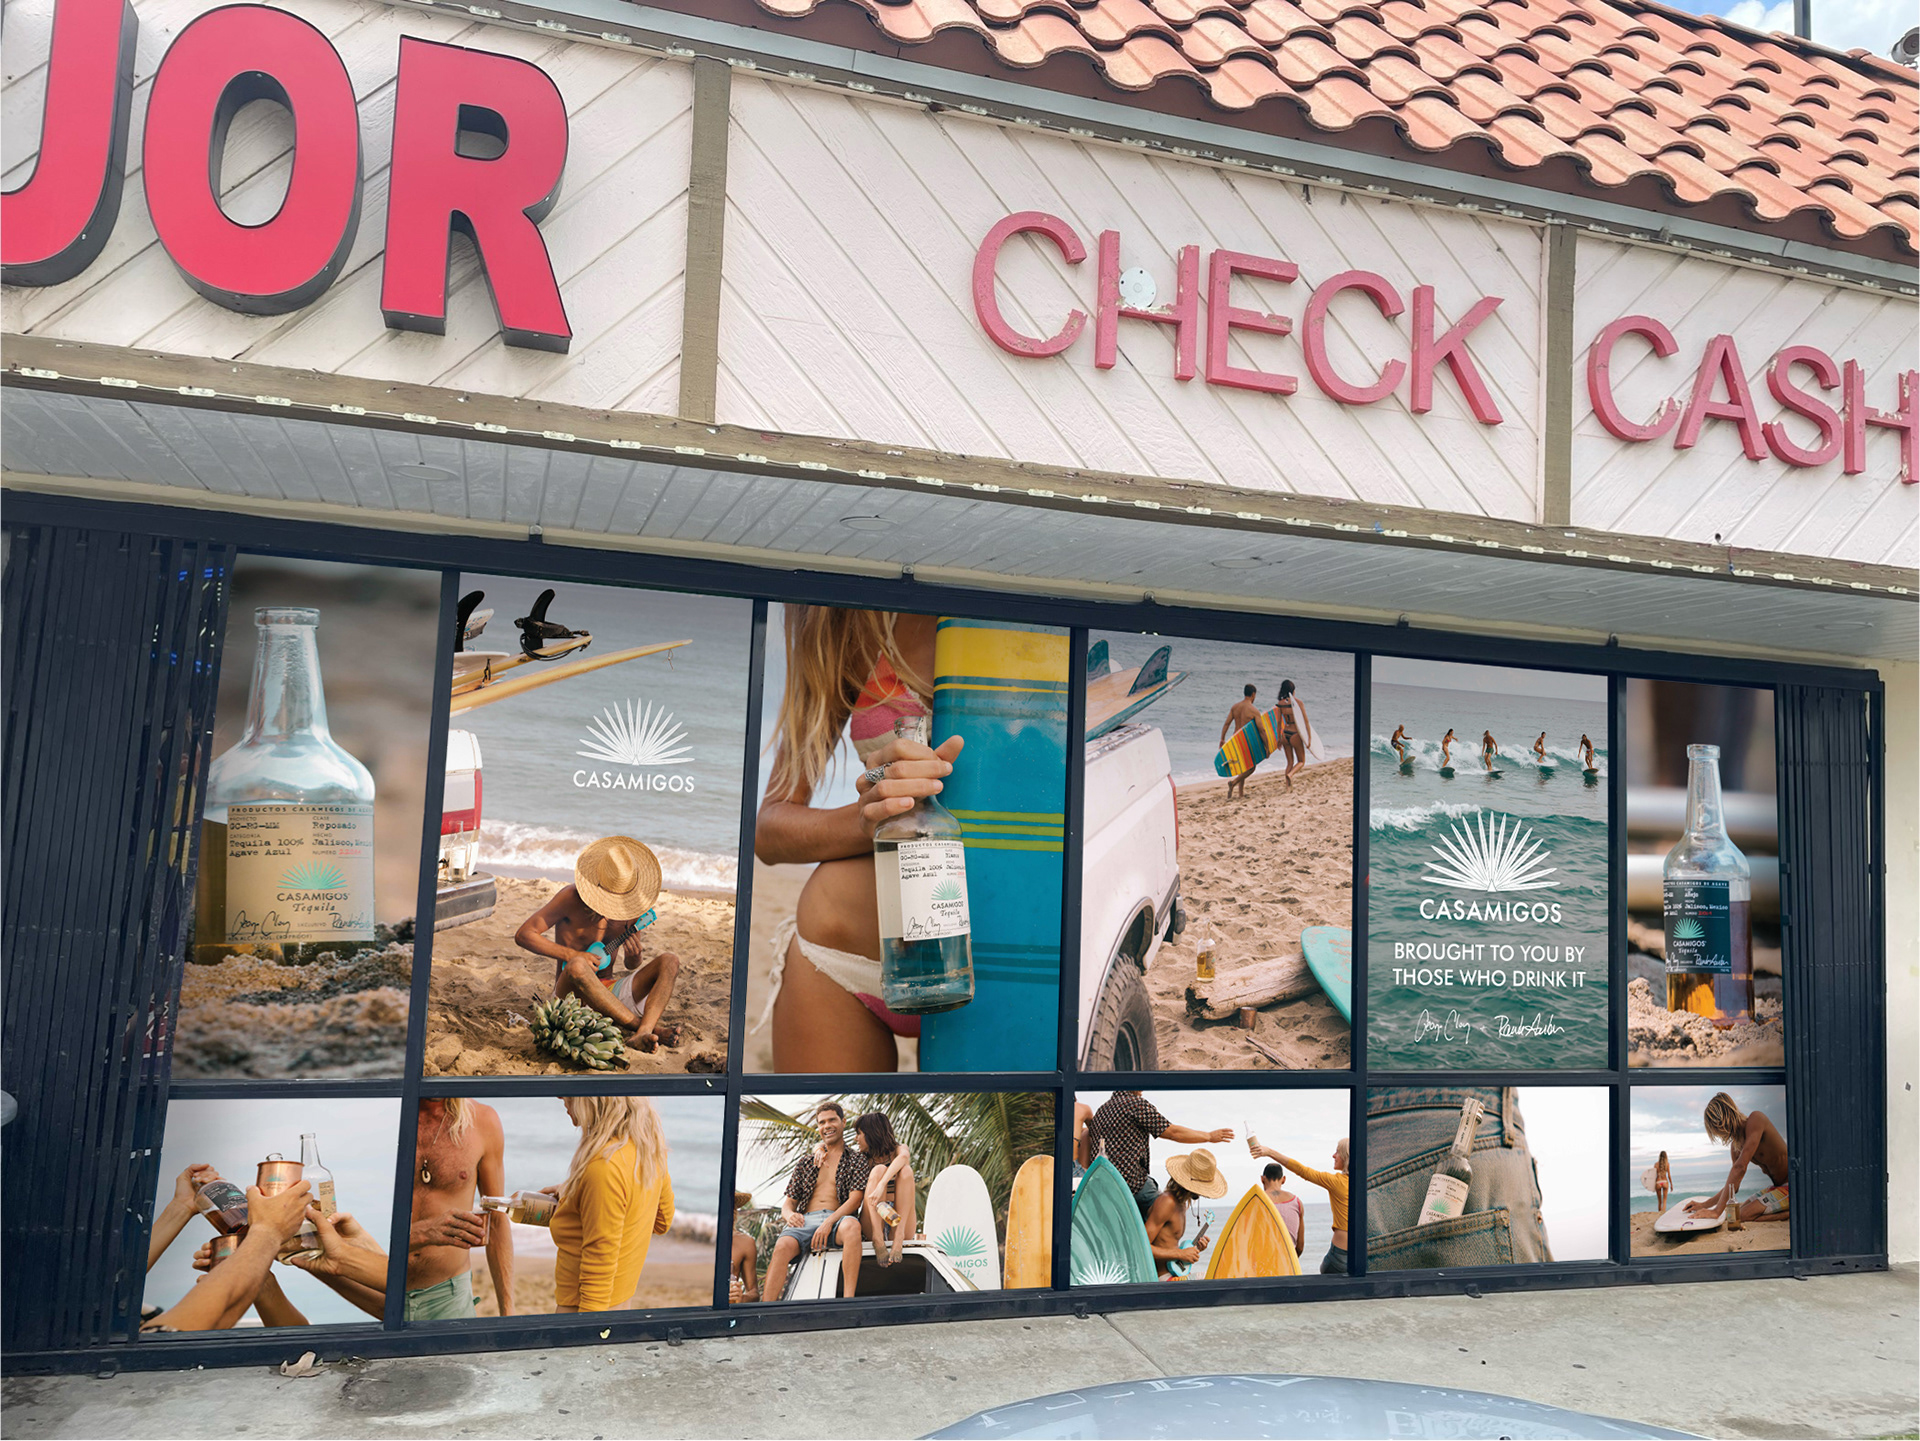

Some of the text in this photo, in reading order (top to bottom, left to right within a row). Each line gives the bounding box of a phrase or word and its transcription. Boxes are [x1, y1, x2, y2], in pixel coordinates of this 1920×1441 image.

[972, 210, 1919, 486] CHECK CASH
[573, 769, 695, 793] CASAMIGOS
[312, 821, 357, 831] Reposado
[229, 838, 304, 848] Tequila 100%
[312, 838, 354, 847] Jalisco,
[229, 848, 292, 858] Agave Azul
[276, 892, 349, 902] CASAMIGOS
[293, 902, 336, 914] Tequila
[931, 901, 964, 910] CASAMIGOS
[1419, 899, 1562, 923] CASAMIGOS
[1672, 940, 1706, 948] CASAMIGOS
[1394, 942, 1586, 963] BROUGHT TO YOU BY
[1392, 968, 1587, 988] THOSE WHO DRINK IT
